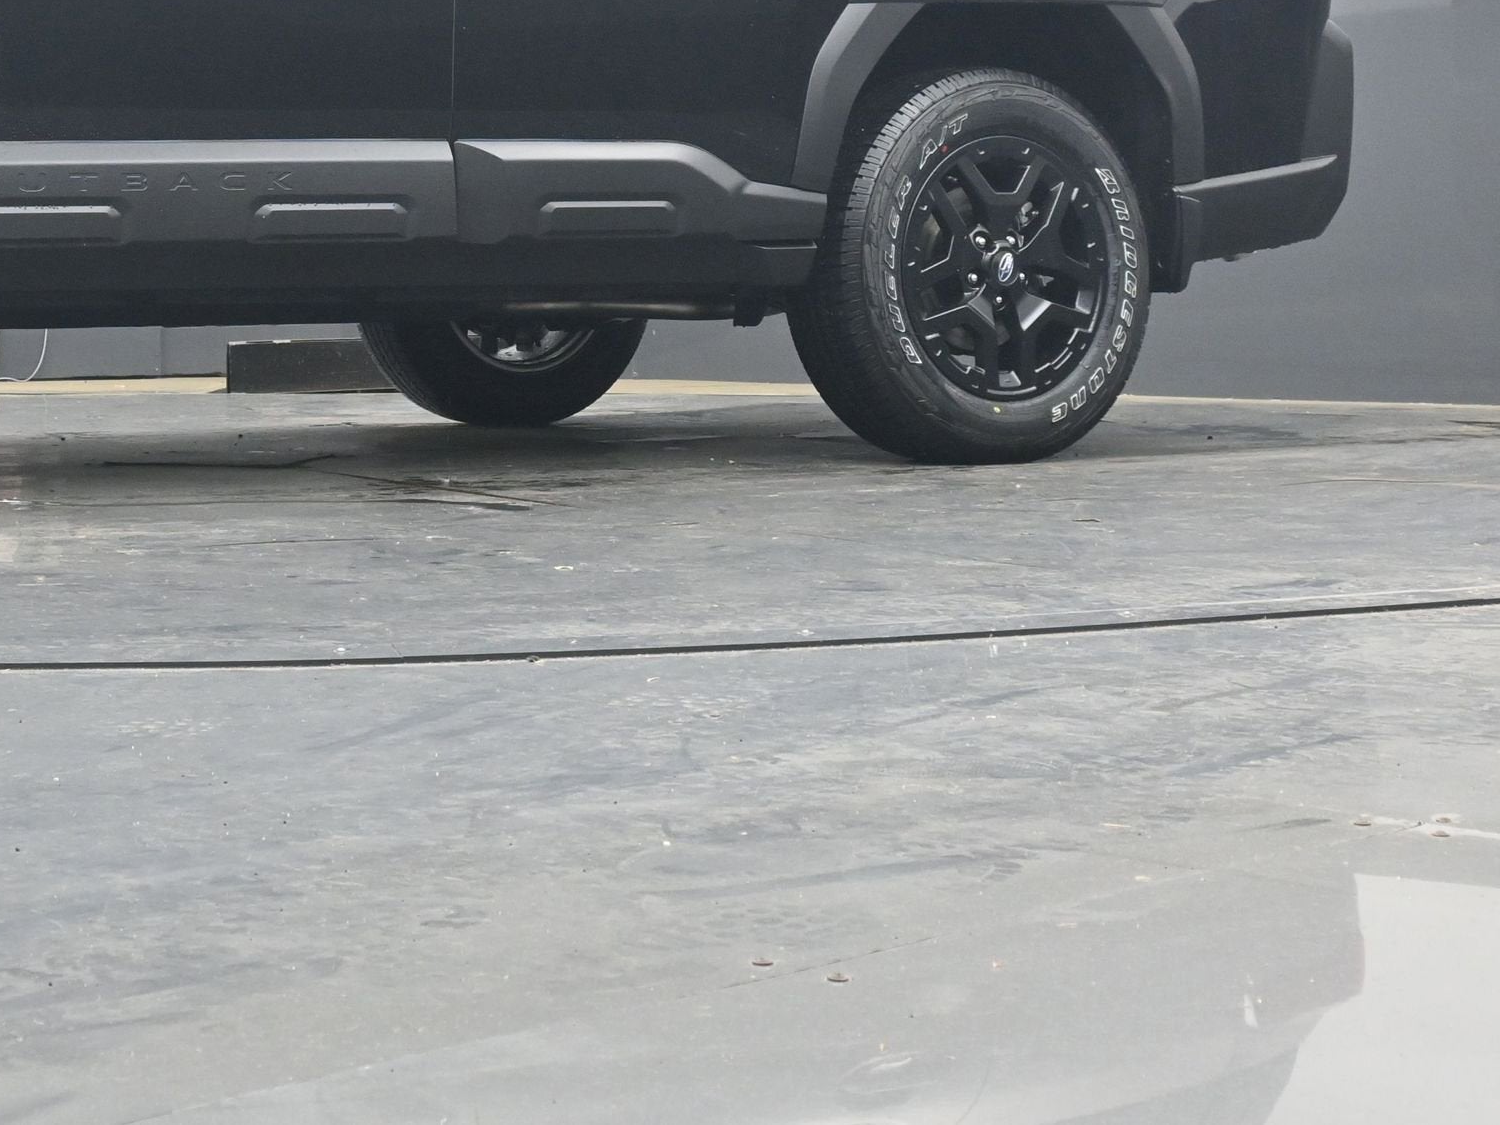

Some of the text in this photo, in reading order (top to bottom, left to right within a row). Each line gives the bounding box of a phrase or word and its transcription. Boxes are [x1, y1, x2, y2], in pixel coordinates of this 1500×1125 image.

[885, 113, 969, 365] DUELER A/T
[1051, 168, 1139, 423] BRIDGESTONE
